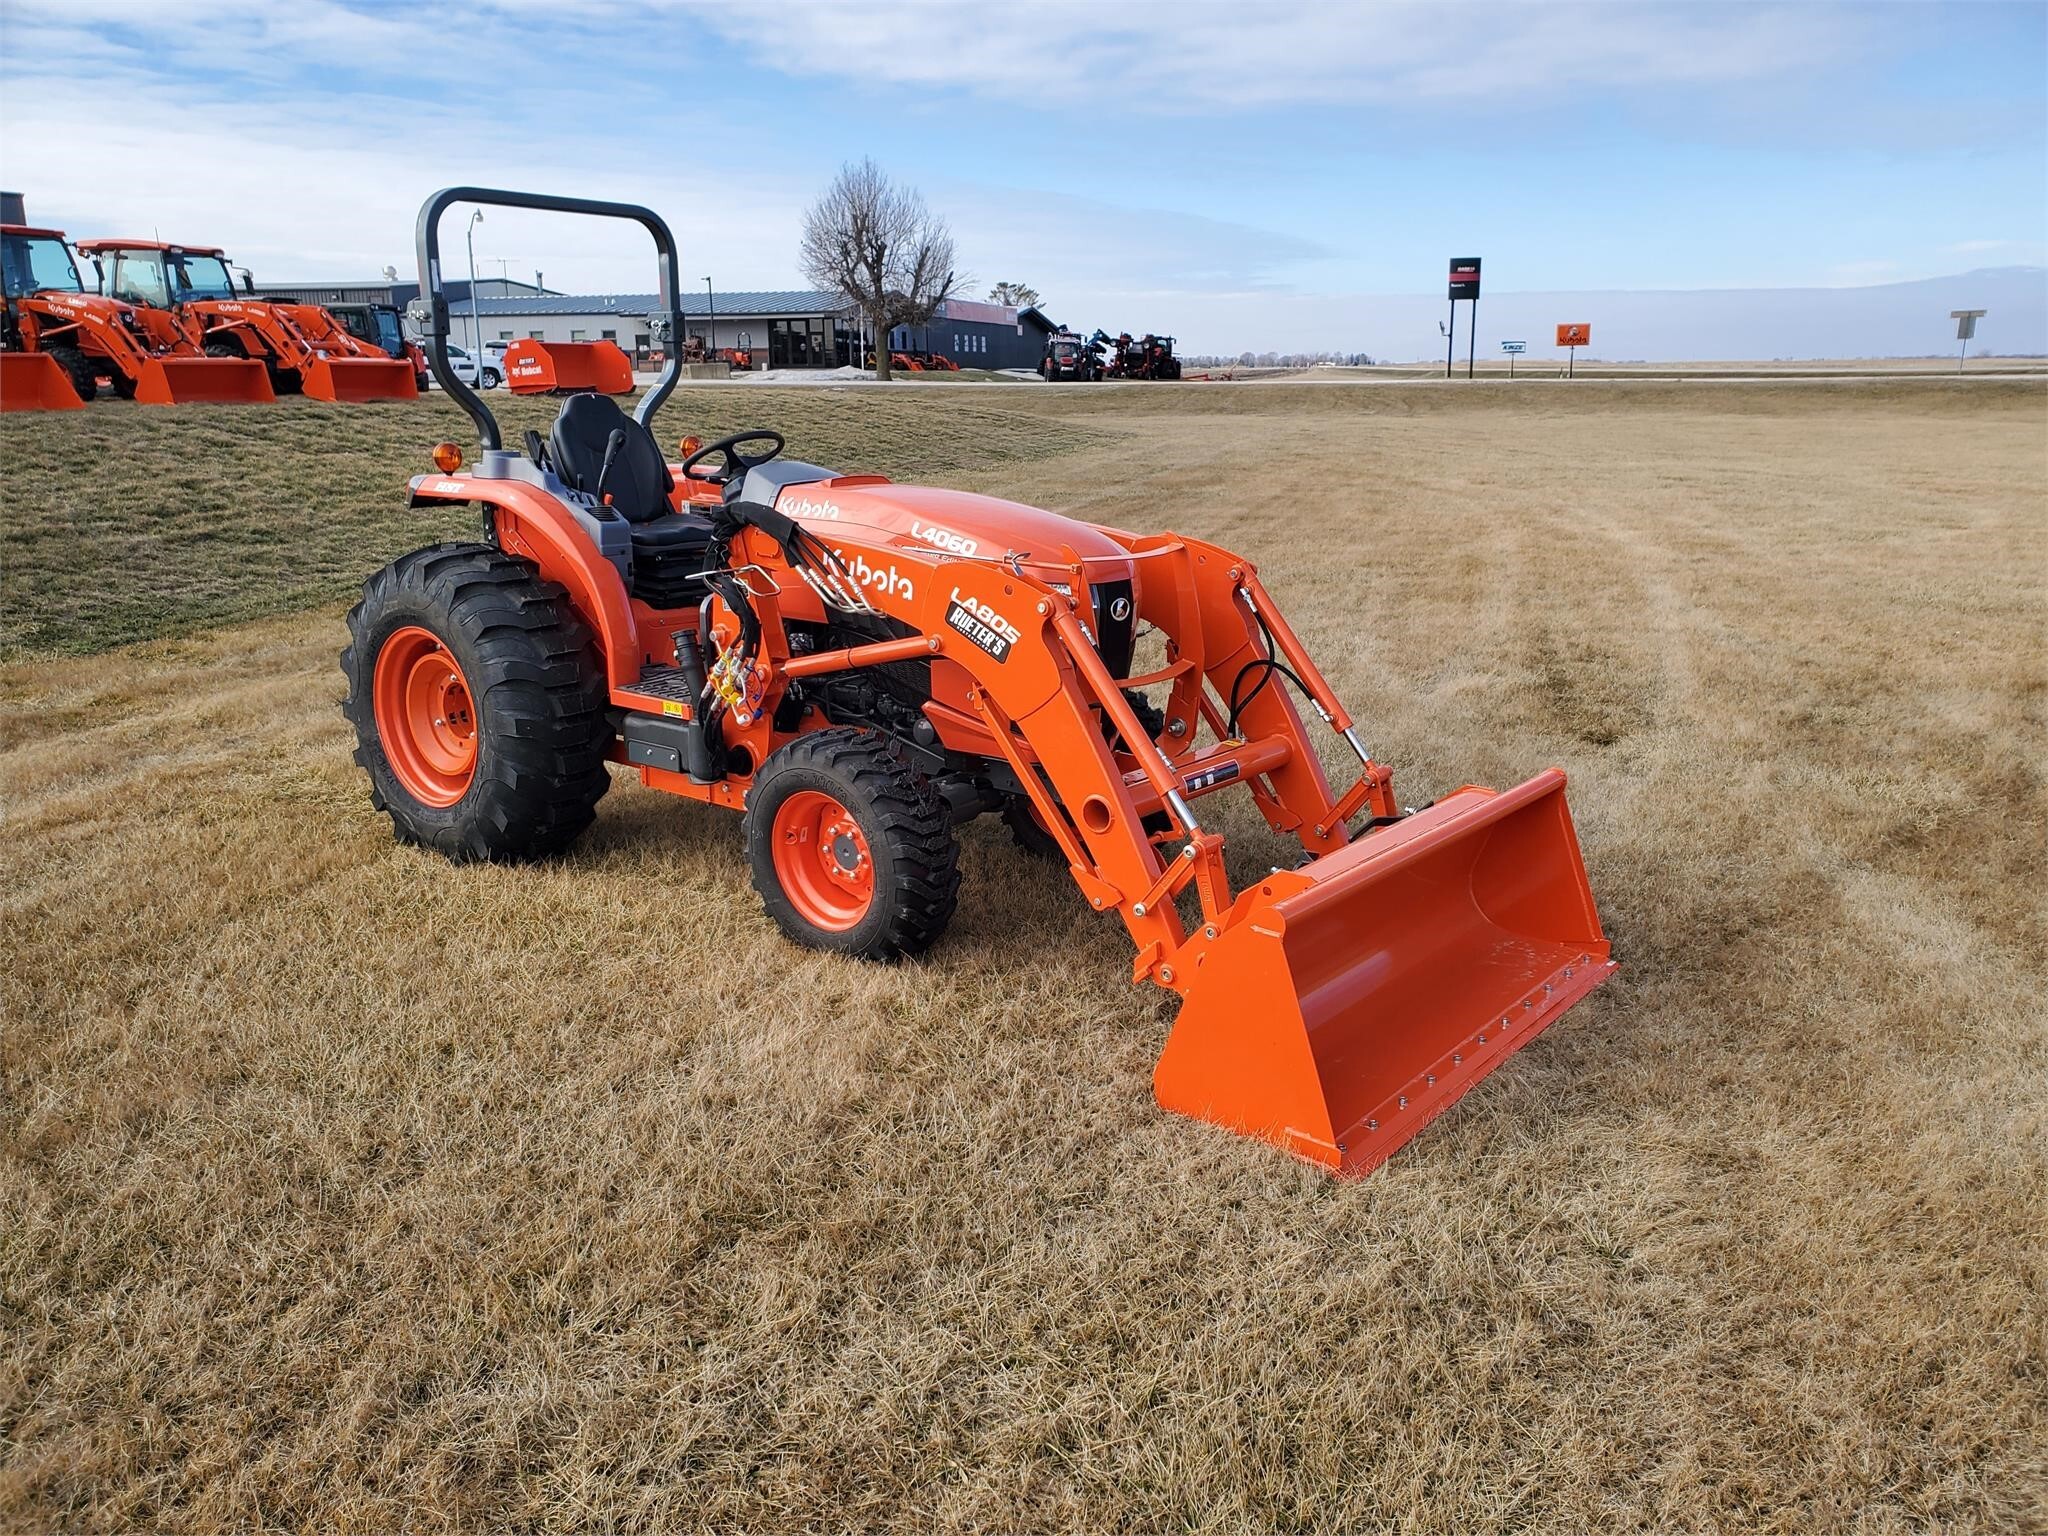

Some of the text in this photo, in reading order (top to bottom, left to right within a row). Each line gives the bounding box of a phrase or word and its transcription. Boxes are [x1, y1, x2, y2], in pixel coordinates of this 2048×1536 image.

[48, 303, 75, 317] Kubota
[1560, 336, 1587, 344] Kubota
[779, 496, 840, 520] Kubota
[910, 521, 978, 556] L4060
[822, 548, 914, 601] Kubota
[949, 606, 1007, 656] RUETER'S
[950, 586, 1022, 645] LA805
